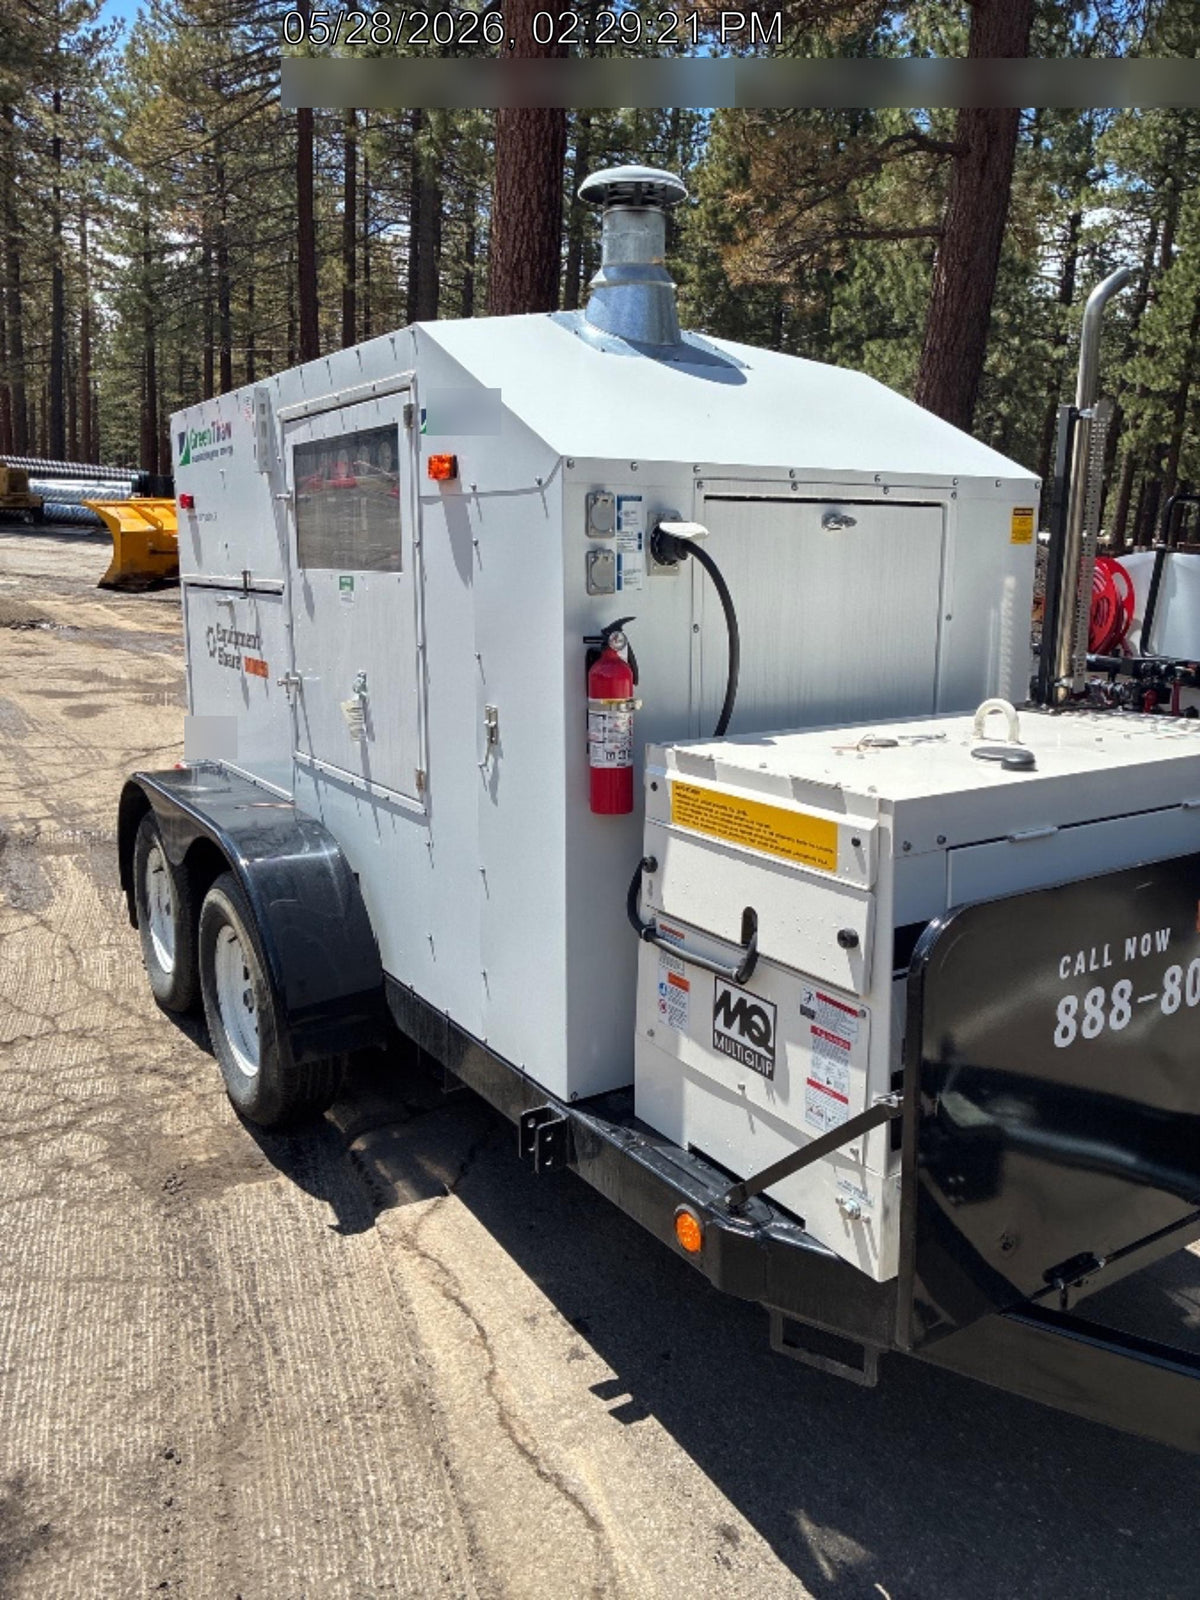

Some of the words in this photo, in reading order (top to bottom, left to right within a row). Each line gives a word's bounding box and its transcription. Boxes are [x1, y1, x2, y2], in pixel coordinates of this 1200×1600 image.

[1058, 943, 1113, 980] CALL
[1124, 927, 1172, 962] NOW
[713, 989, 775, 1056] MQ
